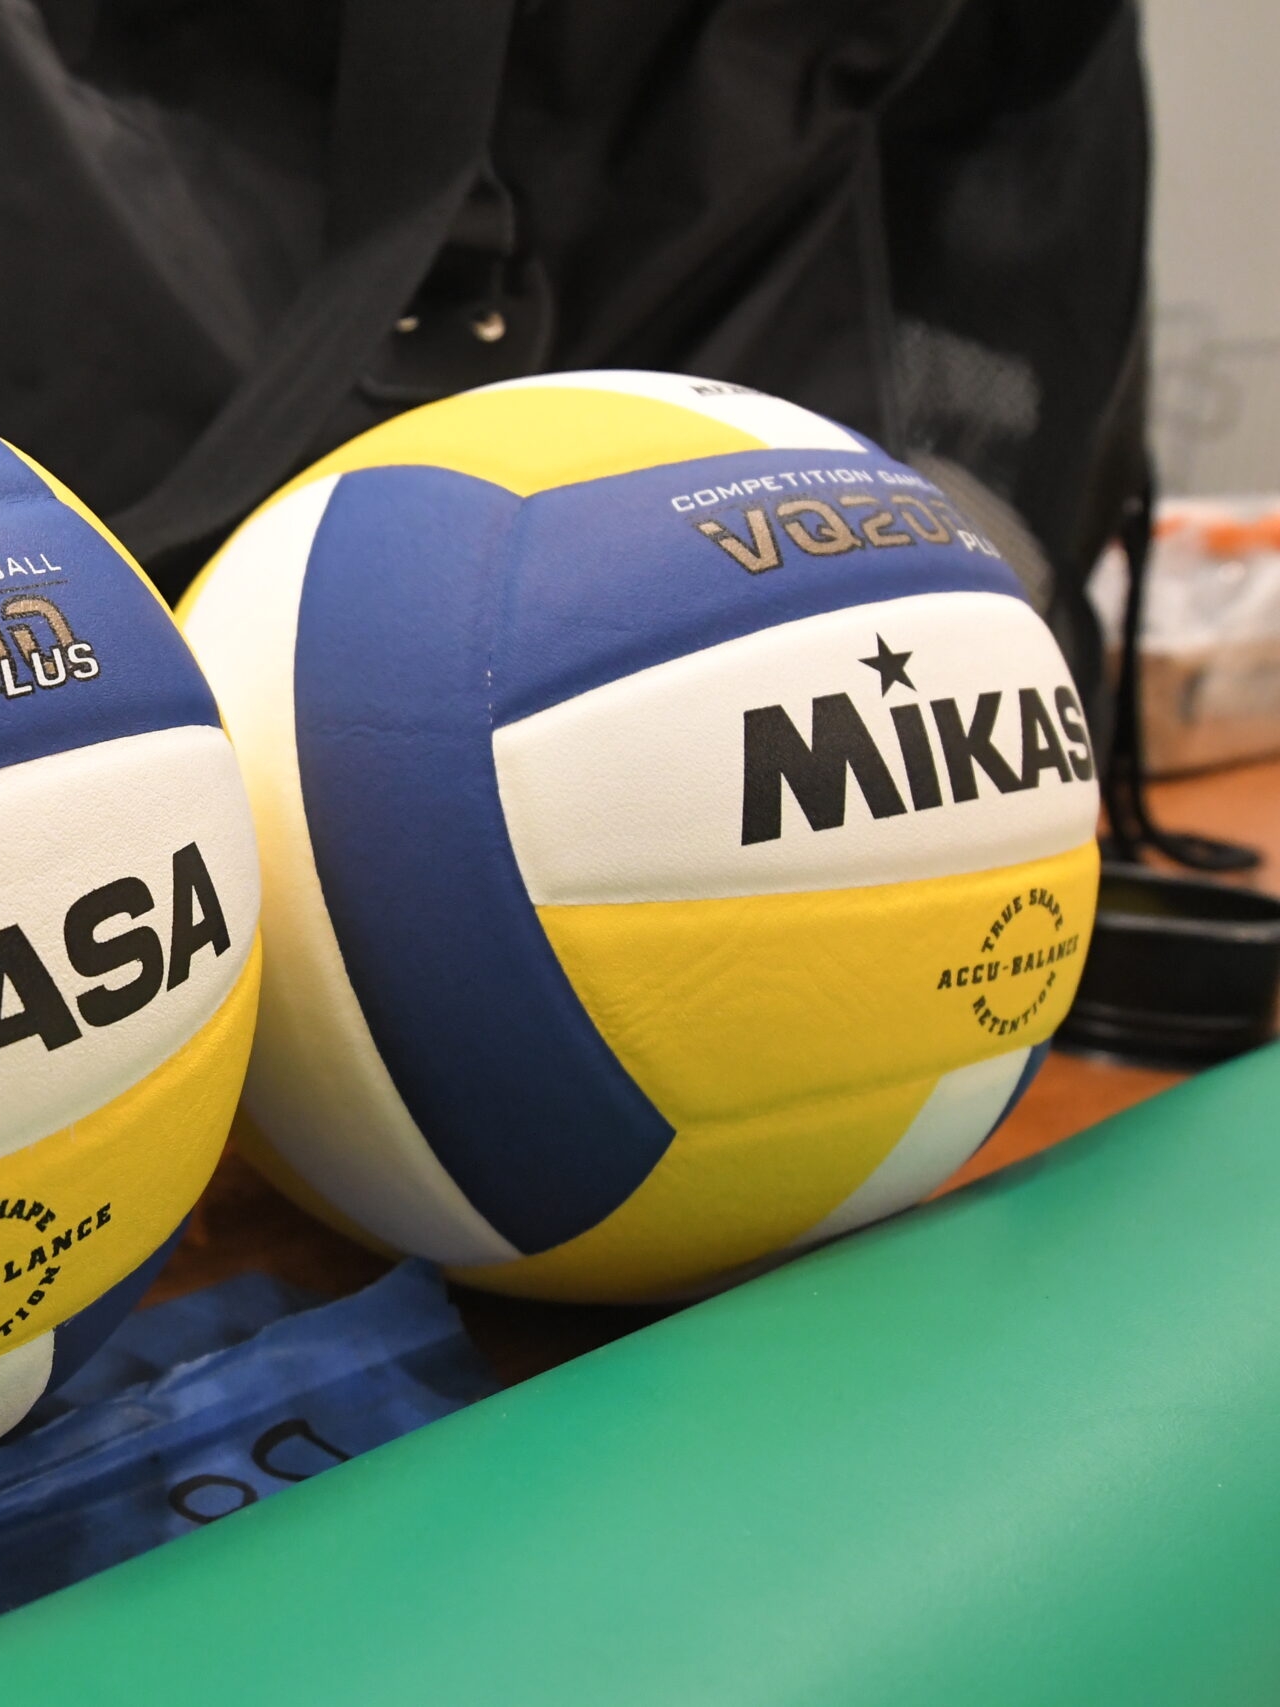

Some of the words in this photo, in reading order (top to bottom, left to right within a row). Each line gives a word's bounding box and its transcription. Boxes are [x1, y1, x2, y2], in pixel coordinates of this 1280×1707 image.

[671, 469, 873, 512] COMPETITION
[981, 896, 1022, 953] TRUE
[1029, 888, 1063, 931] SHAPE
[936, 934, 1079, 990] ACCU-BALANCE
[972, 971, 1056, 1036] RETENTION
